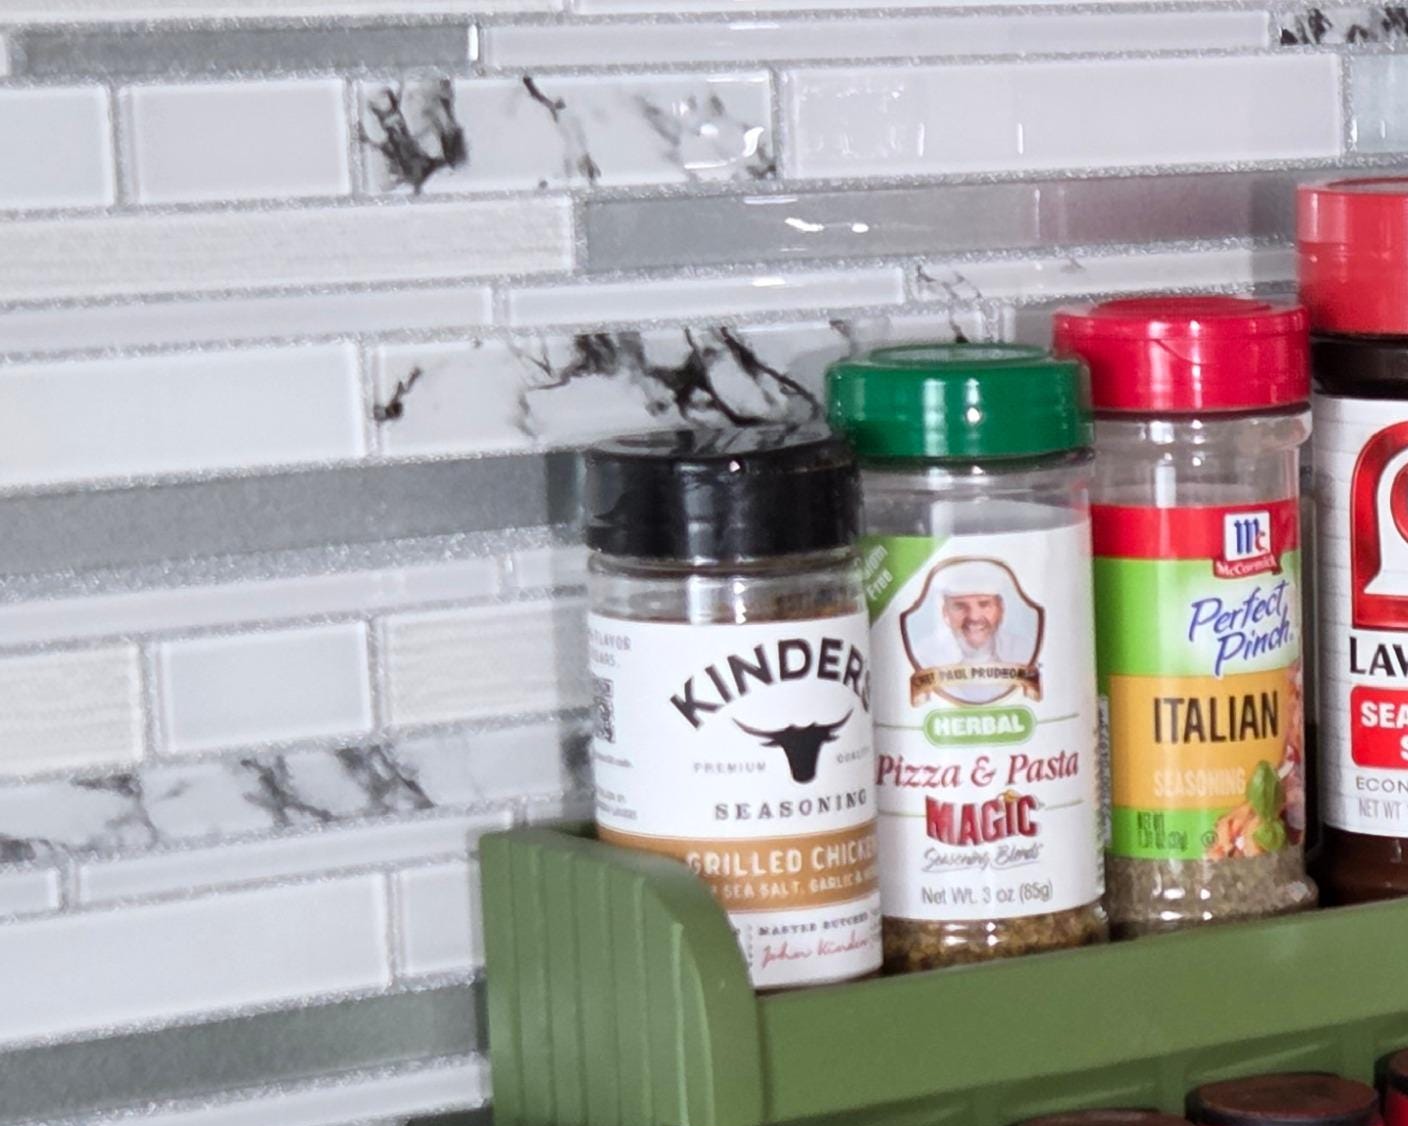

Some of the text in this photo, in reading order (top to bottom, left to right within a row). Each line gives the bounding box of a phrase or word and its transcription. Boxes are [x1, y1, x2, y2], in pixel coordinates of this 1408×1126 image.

[1188, 579, 1289, 642] Perfect
[933, 713, 1025, 737] HERBAL
[1154, 689, 1279, 745] ITALIAN
[694, 762, 767, 773] PREMIUM
[876, 749, 1080, 789] Pizza & Pasta
[1153, 766, 1247, 798] SEASONING
[714, 787, 868, 820] SEASONING
[1358, 799, 1378, 818] NET
[1383, 800, 1400, 819] WT
[924, 792, 1039, 847] MAGIC
[686, 848, 804, 877] GRILLED
[723, 883, 755, 900] SEA
[921, 886, 947, 905] Net
[981, 886, 992, 905] 3
[995, 889, 1016, 905] oz
[1019, 878, 1054, 905] (85g)
